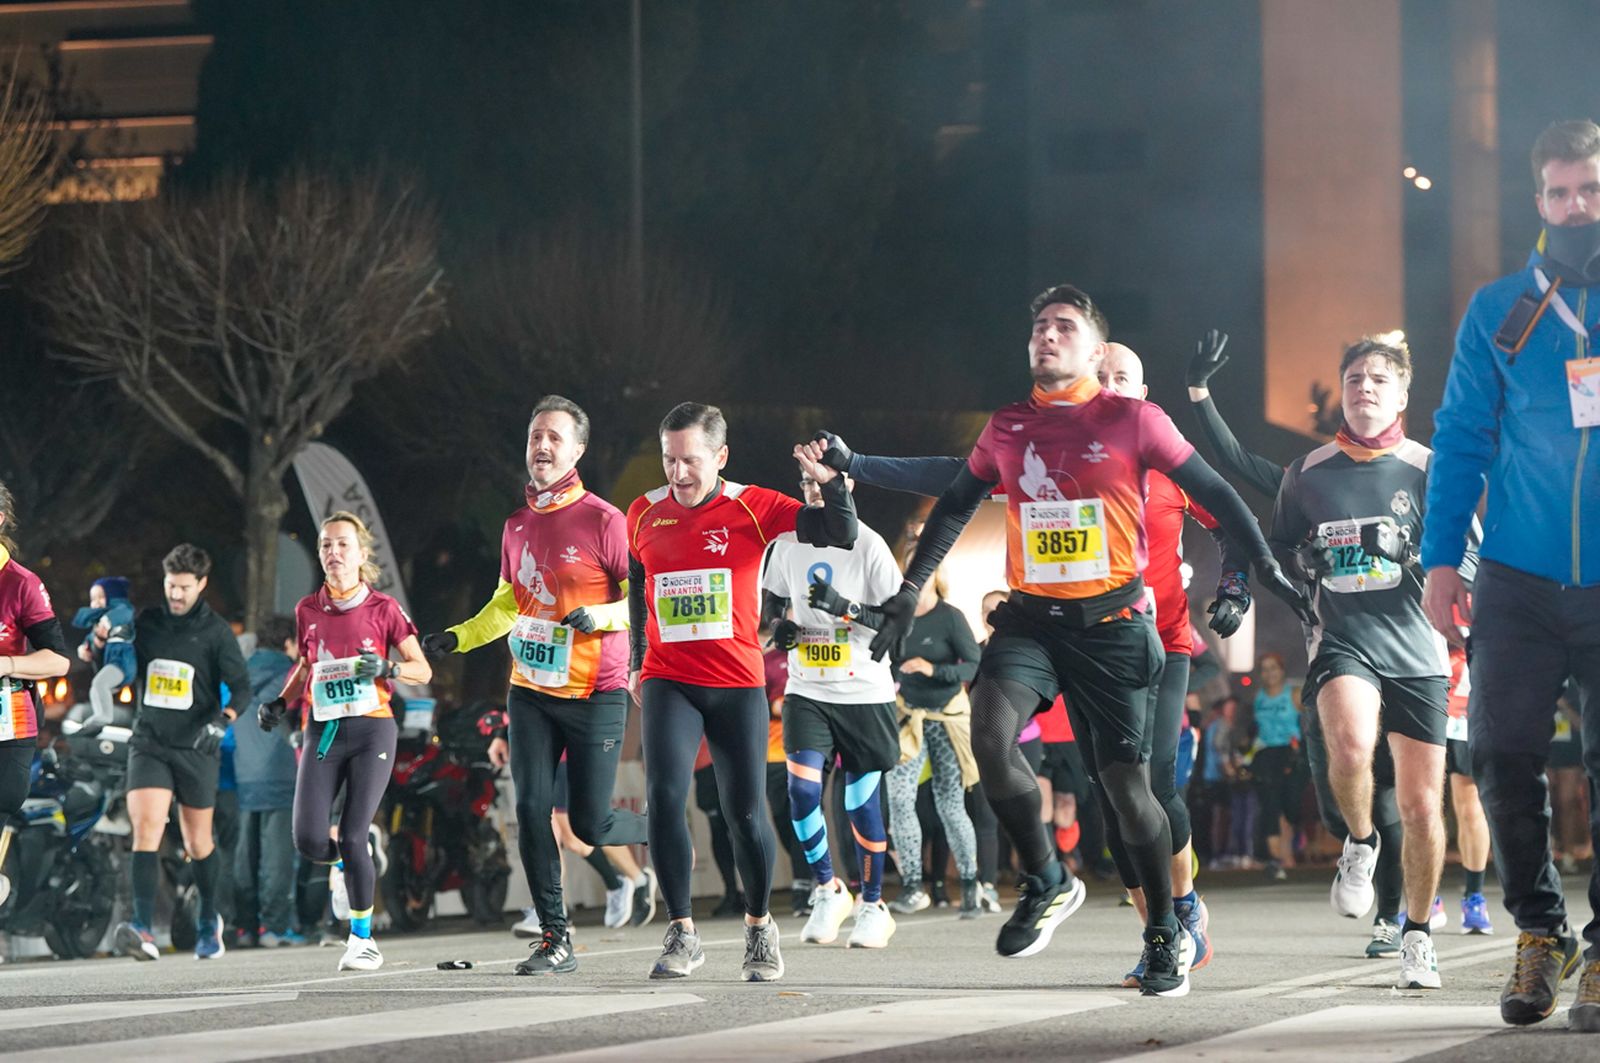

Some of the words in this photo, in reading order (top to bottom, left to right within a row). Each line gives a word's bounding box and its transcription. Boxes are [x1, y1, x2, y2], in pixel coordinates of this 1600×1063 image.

[1335, 527, 1359, 537] NOCHE
[1037, 530, 1088, 555] 3857
[1328, 538, 1343, 547] SAN
[1337, 546, 1376, 568] 122
[670, 578, 692, 587] NOCHE
[693, 577, 703, 586] DE
[662, 588, 678, 597] SAN
[670, 594, 717, 618] 7831
[806, 644, 841, 662] 1906
